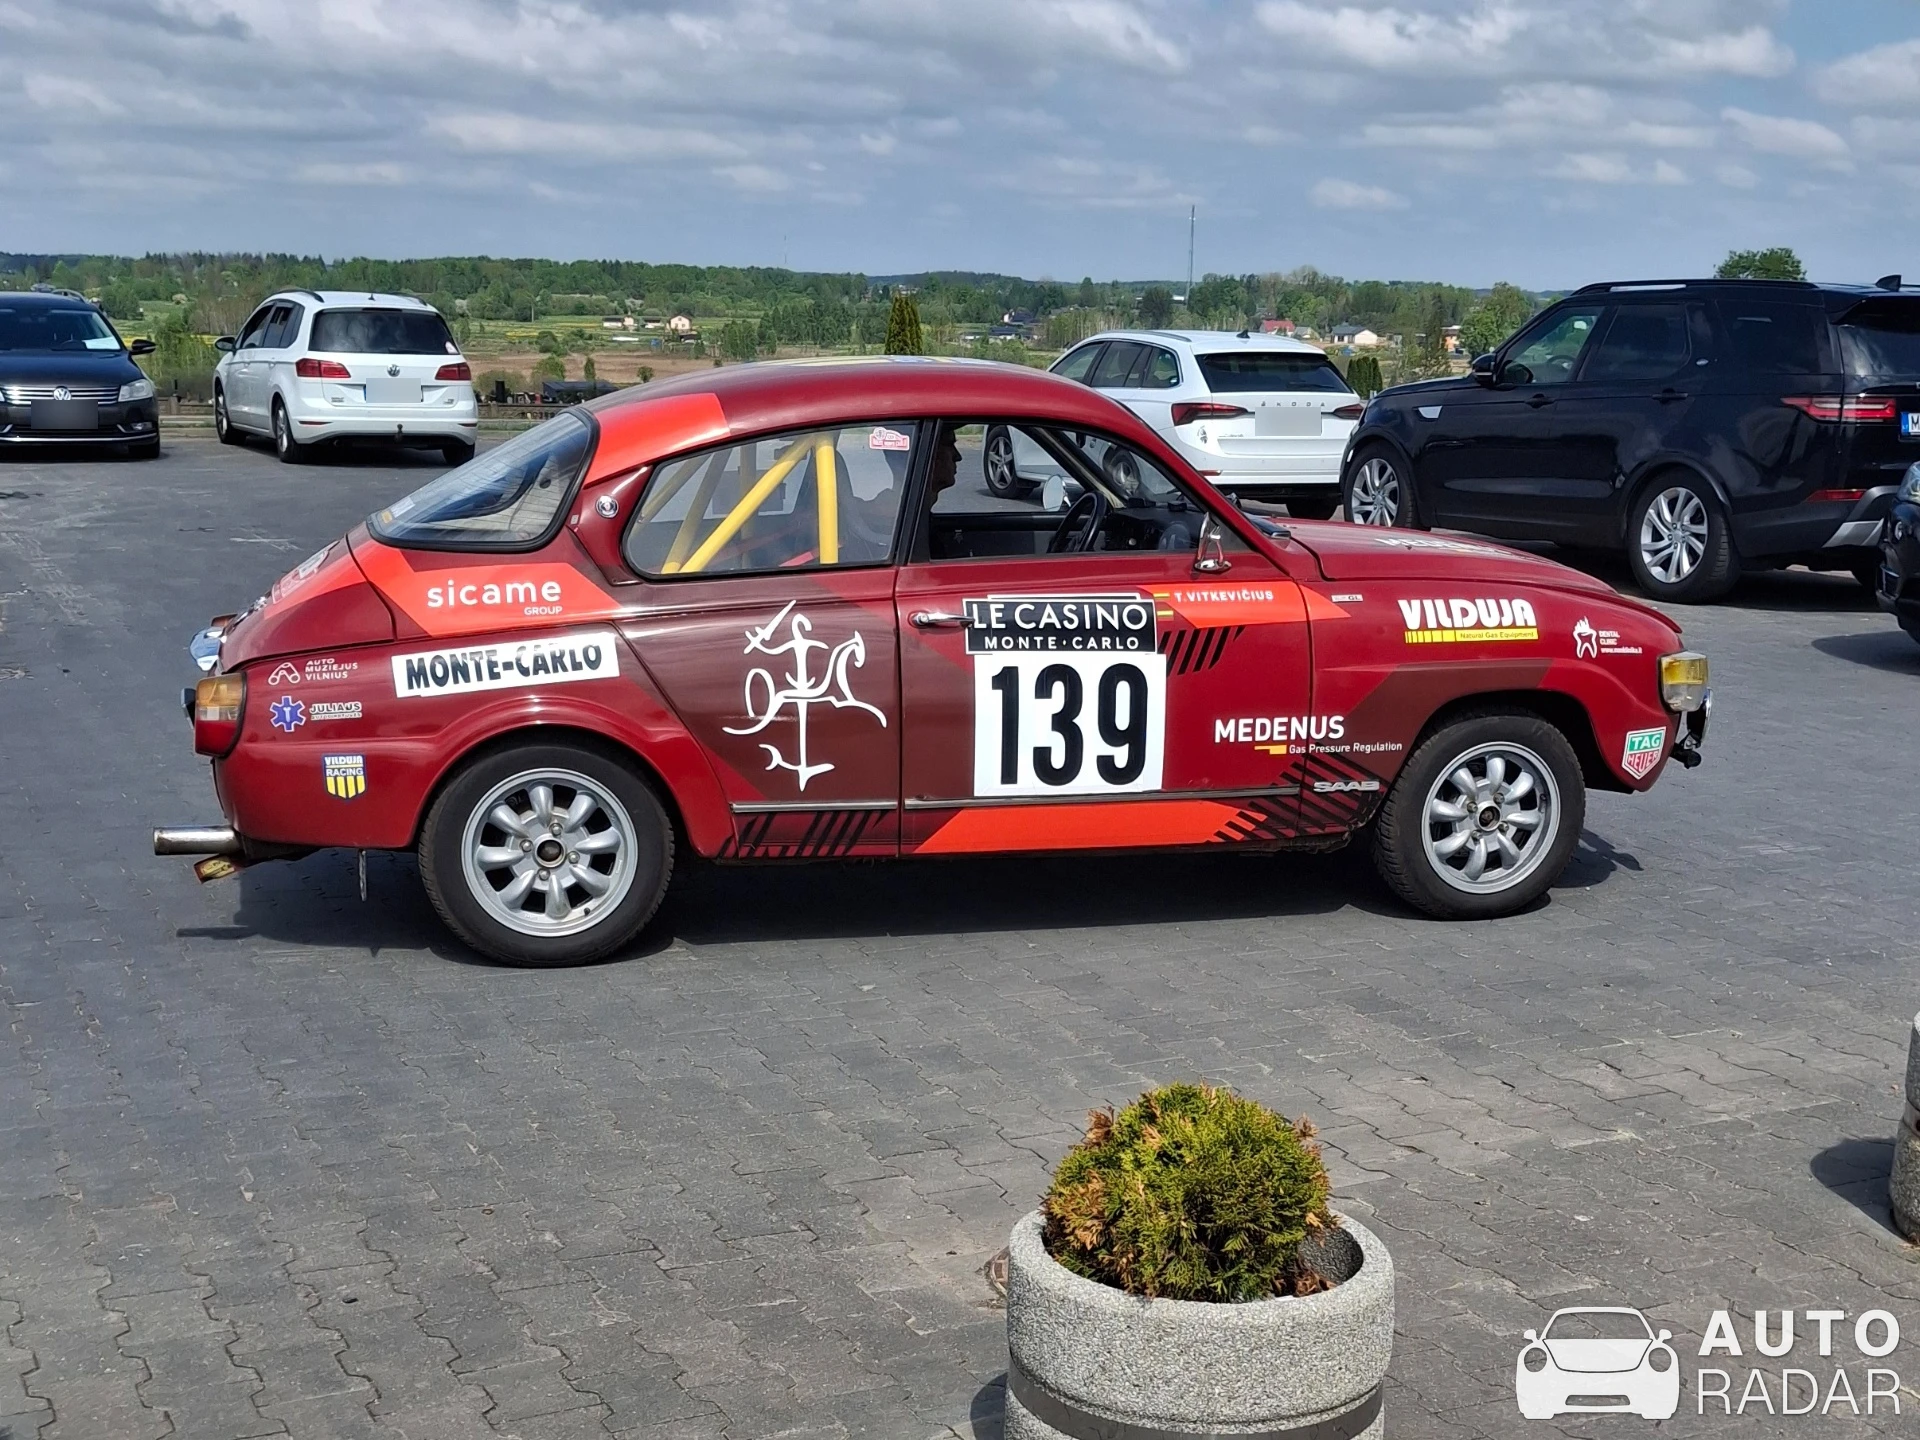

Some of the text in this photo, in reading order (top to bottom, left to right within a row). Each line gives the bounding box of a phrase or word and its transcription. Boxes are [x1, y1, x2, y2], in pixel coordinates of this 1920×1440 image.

[427, 579, 562, 608] sicame
[523, 605, 563, 616] GROUP
[972, 603, 1148, 630] LE CASINO
[1397, 598, 1537, 630] VILDUJA
[1460, 631, 1534, 639] Natural Gas Equipment
[305, 662, 359, 673] MUZIEJUS
[306, 657, 335, 666] AUTO
[405, 643, 602, 690] MONTE-CARLO
[305, 670, 348, 681] VILNIUS
[310, 702, 361, 713] JULIAUS
[991, 662, 1148, 786] 139
[1214, 715, 1345, 743] MEDENUS
[1289, 741, 1402, 754] Gas Pressure Regulation
[1631, 734, 1661, 750] TAG
[324, 755, 363, 765] VILDUJA
[1628, 750, 1659, 772] HEUER
[326, 767, 364, 776] RACING
[1313, 780, 1380, 793] SAAB
